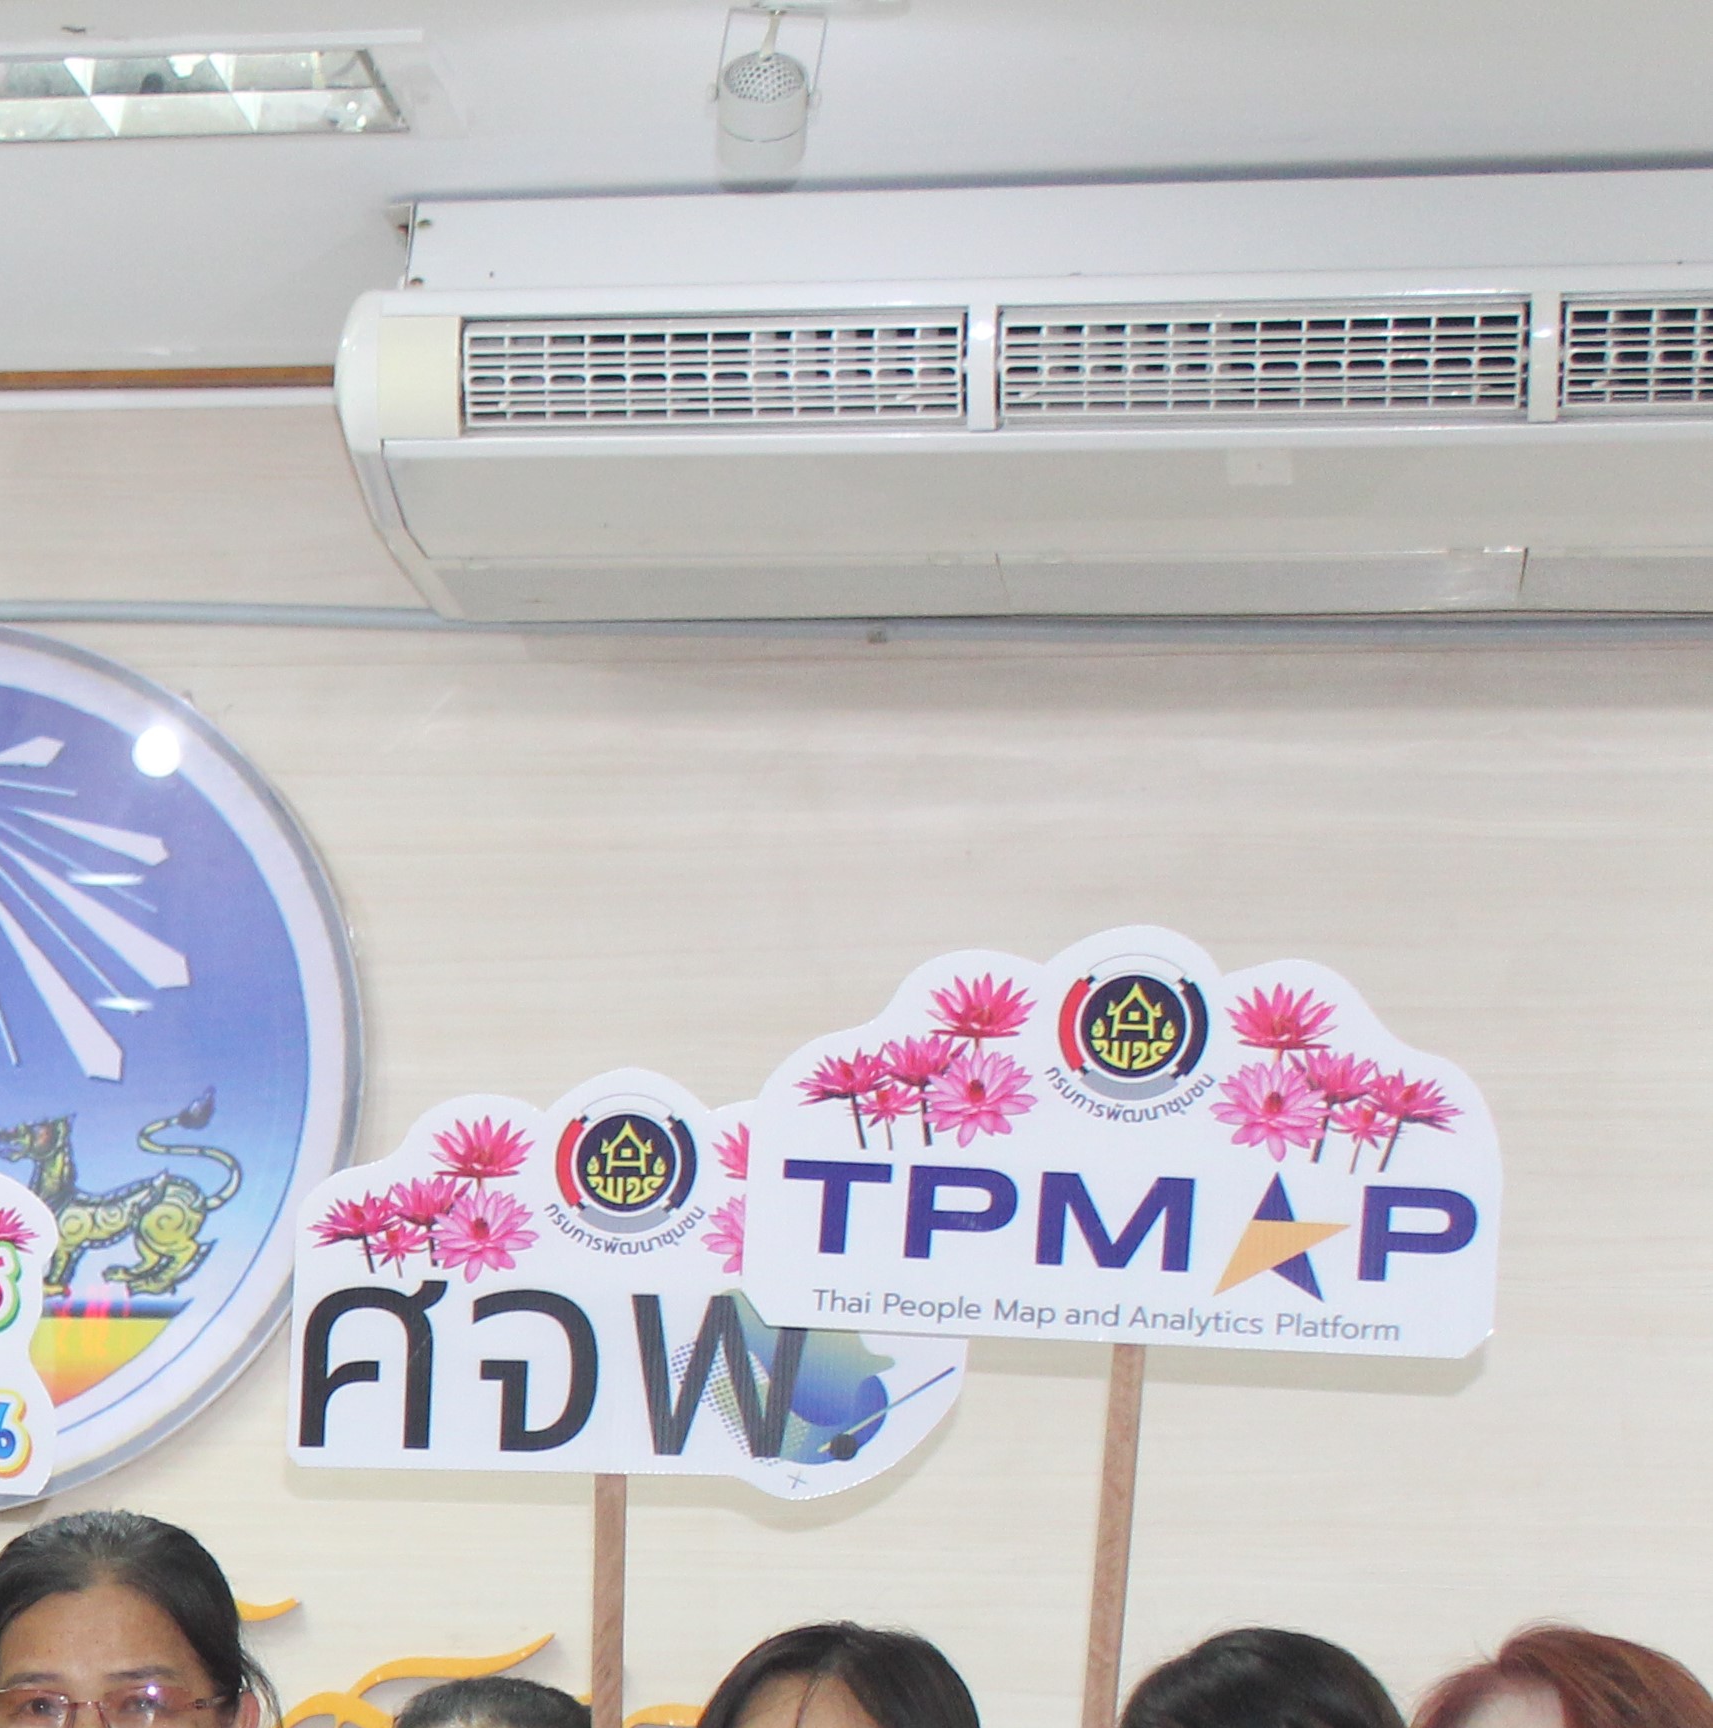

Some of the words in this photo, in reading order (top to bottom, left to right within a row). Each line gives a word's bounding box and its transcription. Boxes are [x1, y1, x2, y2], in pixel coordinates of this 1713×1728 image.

[1044, 1065, 1216, 1120] กรมการพัฒนาชุมชน
[542, 1199, 707, 1257] กรมการพัฒนาชุมชน
[783, 1157, 1480, 1304] TPMAP
[813, 1287, 873, 1318] Thai
[880, 1291, 982, 1325] People
[992, 1298, 1057, 1332] Map
[1063, 1301, 1121, 1330] and
[1129, 1304, 1264, 1338] Analytics
[1274, 1309, 1402, 1341] Platform
[296, 1279, 811, 1461] ศจพ
